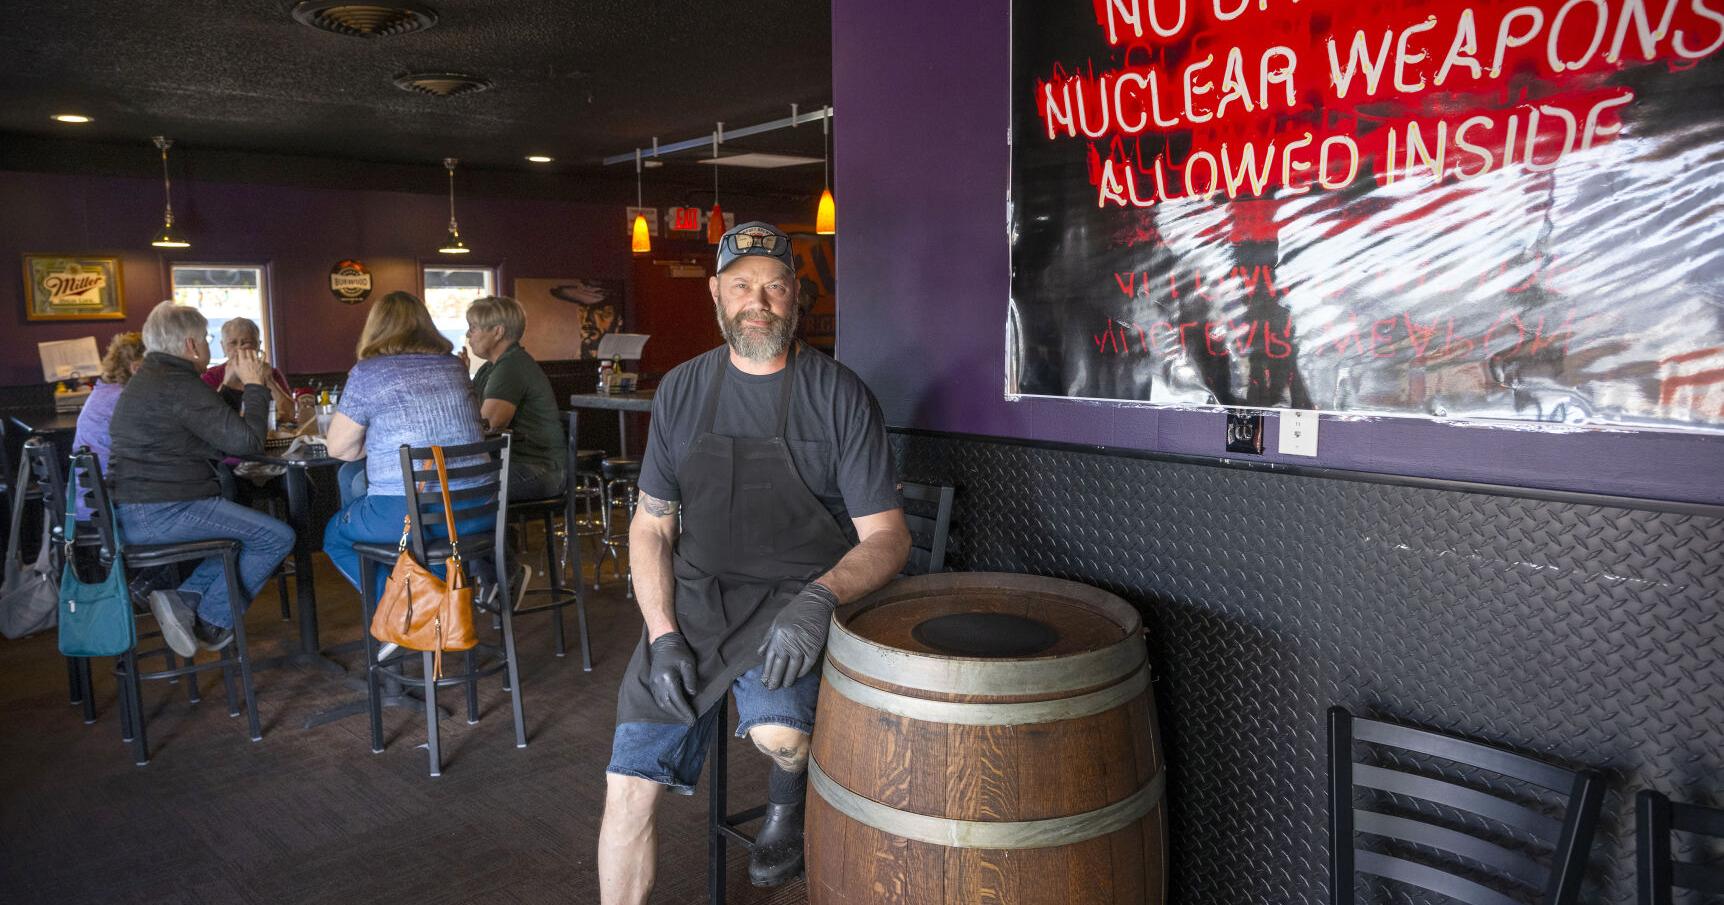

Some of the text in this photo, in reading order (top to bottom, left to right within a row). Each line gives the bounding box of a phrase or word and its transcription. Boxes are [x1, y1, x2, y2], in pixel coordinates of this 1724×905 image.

[1045, 0, 1724, 139] NUCLEAR WEAPONS
[1099, 132, 1359, 208] ALLOWED
[45, 276, 102, 297] Miller
